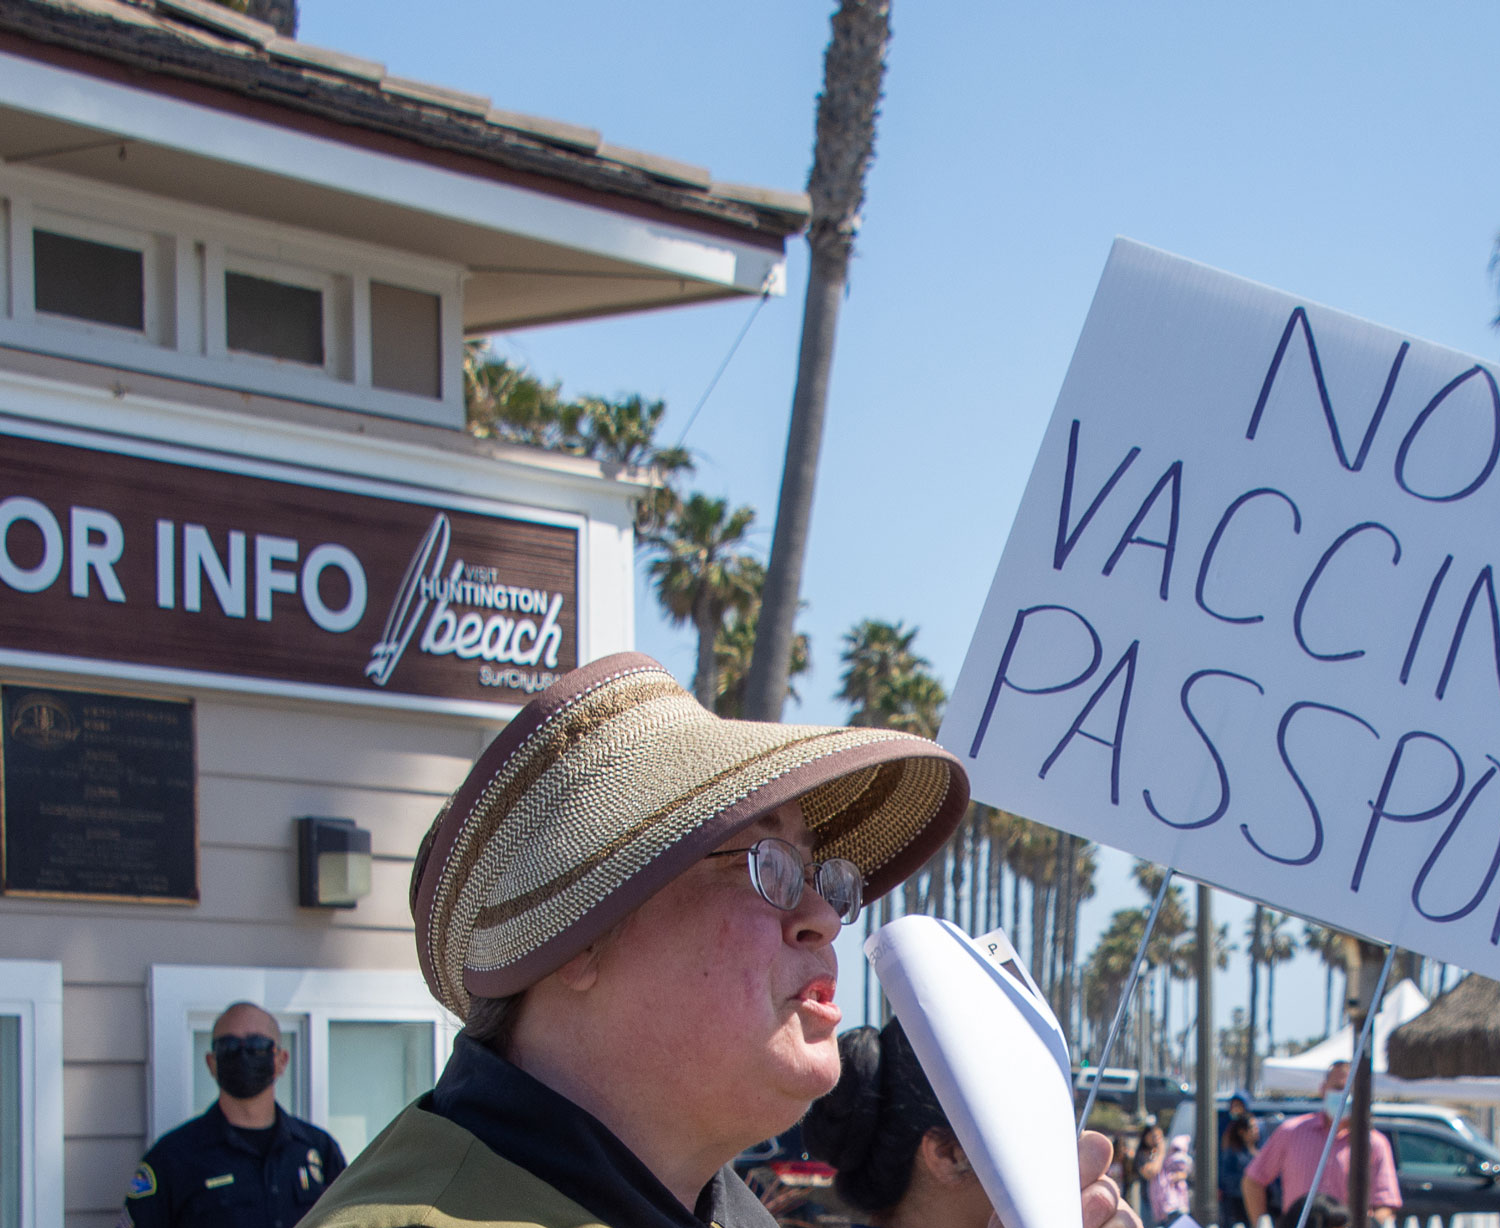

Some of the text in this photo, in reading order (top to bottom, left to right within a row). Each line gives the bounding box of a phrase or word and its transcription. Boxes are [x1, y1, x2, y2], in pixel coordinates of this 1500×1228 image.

[156, 519, 368, 633] INFO
[419, 574, 549, 615] HUNTINGTON
[464, 563, 499, 584] VISIT
[420, 559, 563, 668] beach
